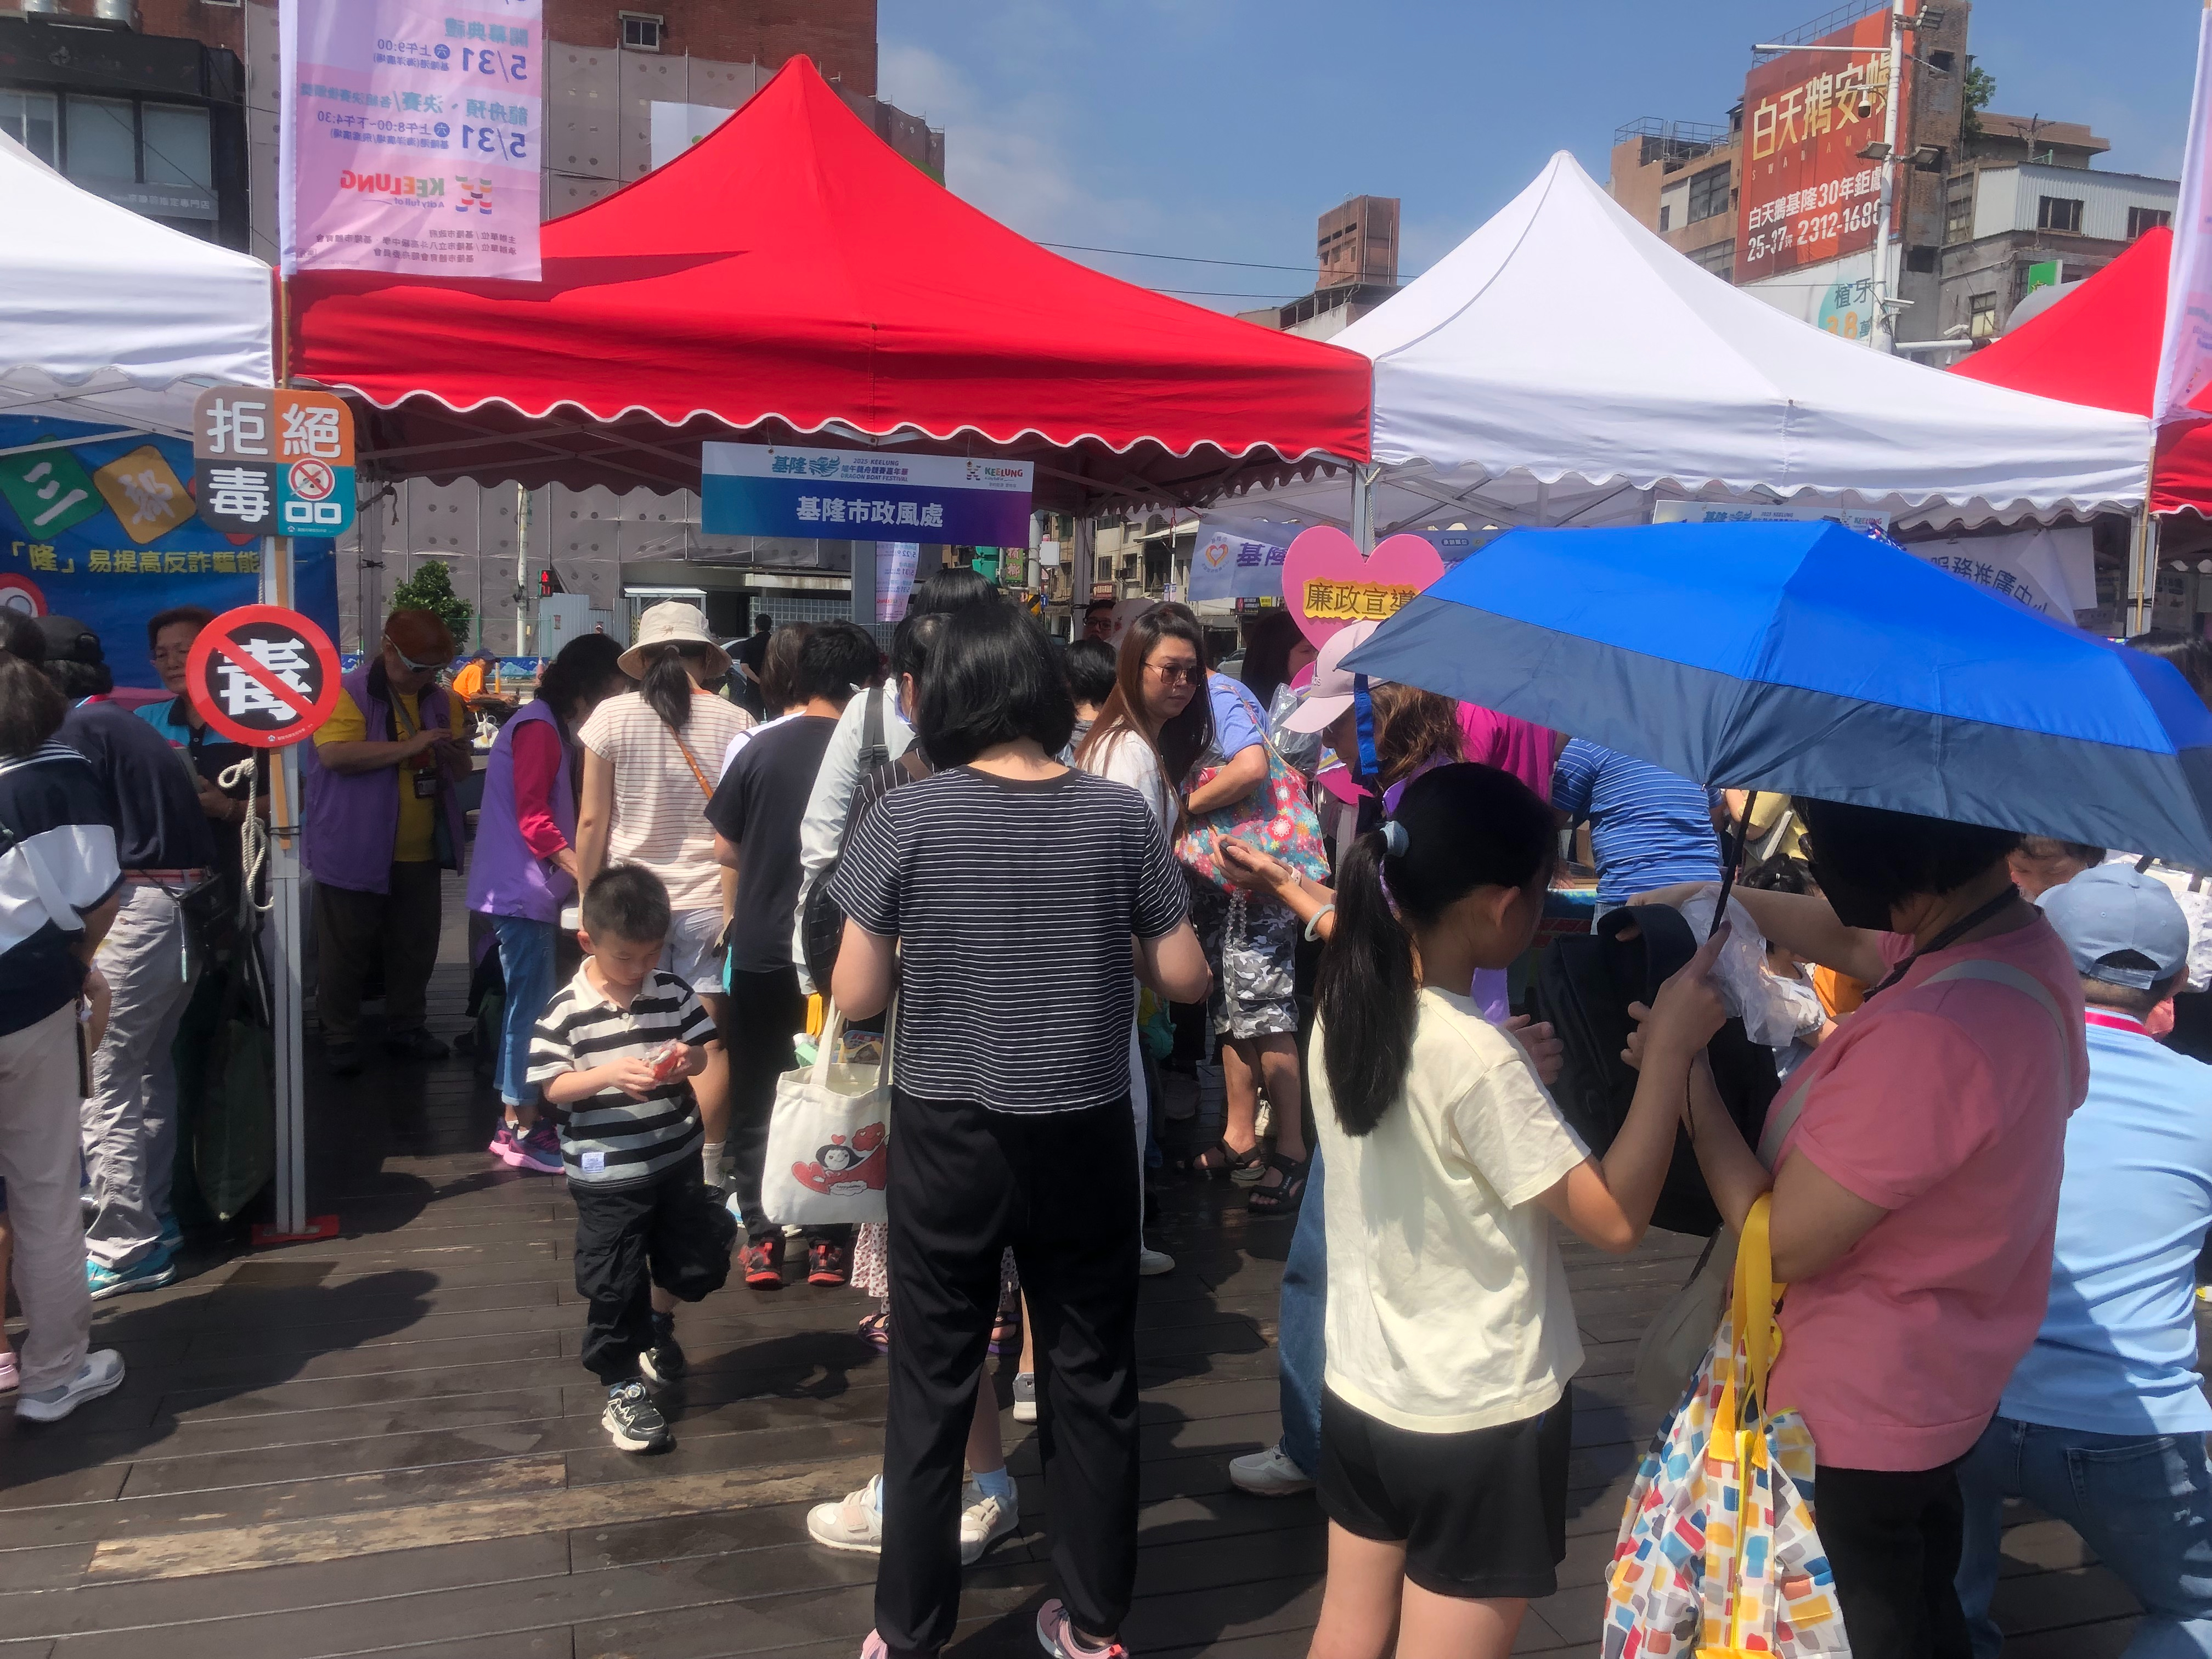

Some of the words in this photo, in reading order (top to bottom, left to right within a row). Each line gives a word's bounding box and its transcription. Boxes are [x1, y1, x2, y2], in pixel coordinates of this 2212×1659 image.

[1834, 278, 1871, 309] 植牙
[206, 398, 341, 458] 拒絕
[772, 456, 808, 474] 基隆
[985, 467, 1023, 478] KEELUNG
[209, 466, 342, 524] 毒品
[796, 495, 944, 528] 基隆市政風處
[217, 637, 315, 723] 毒
